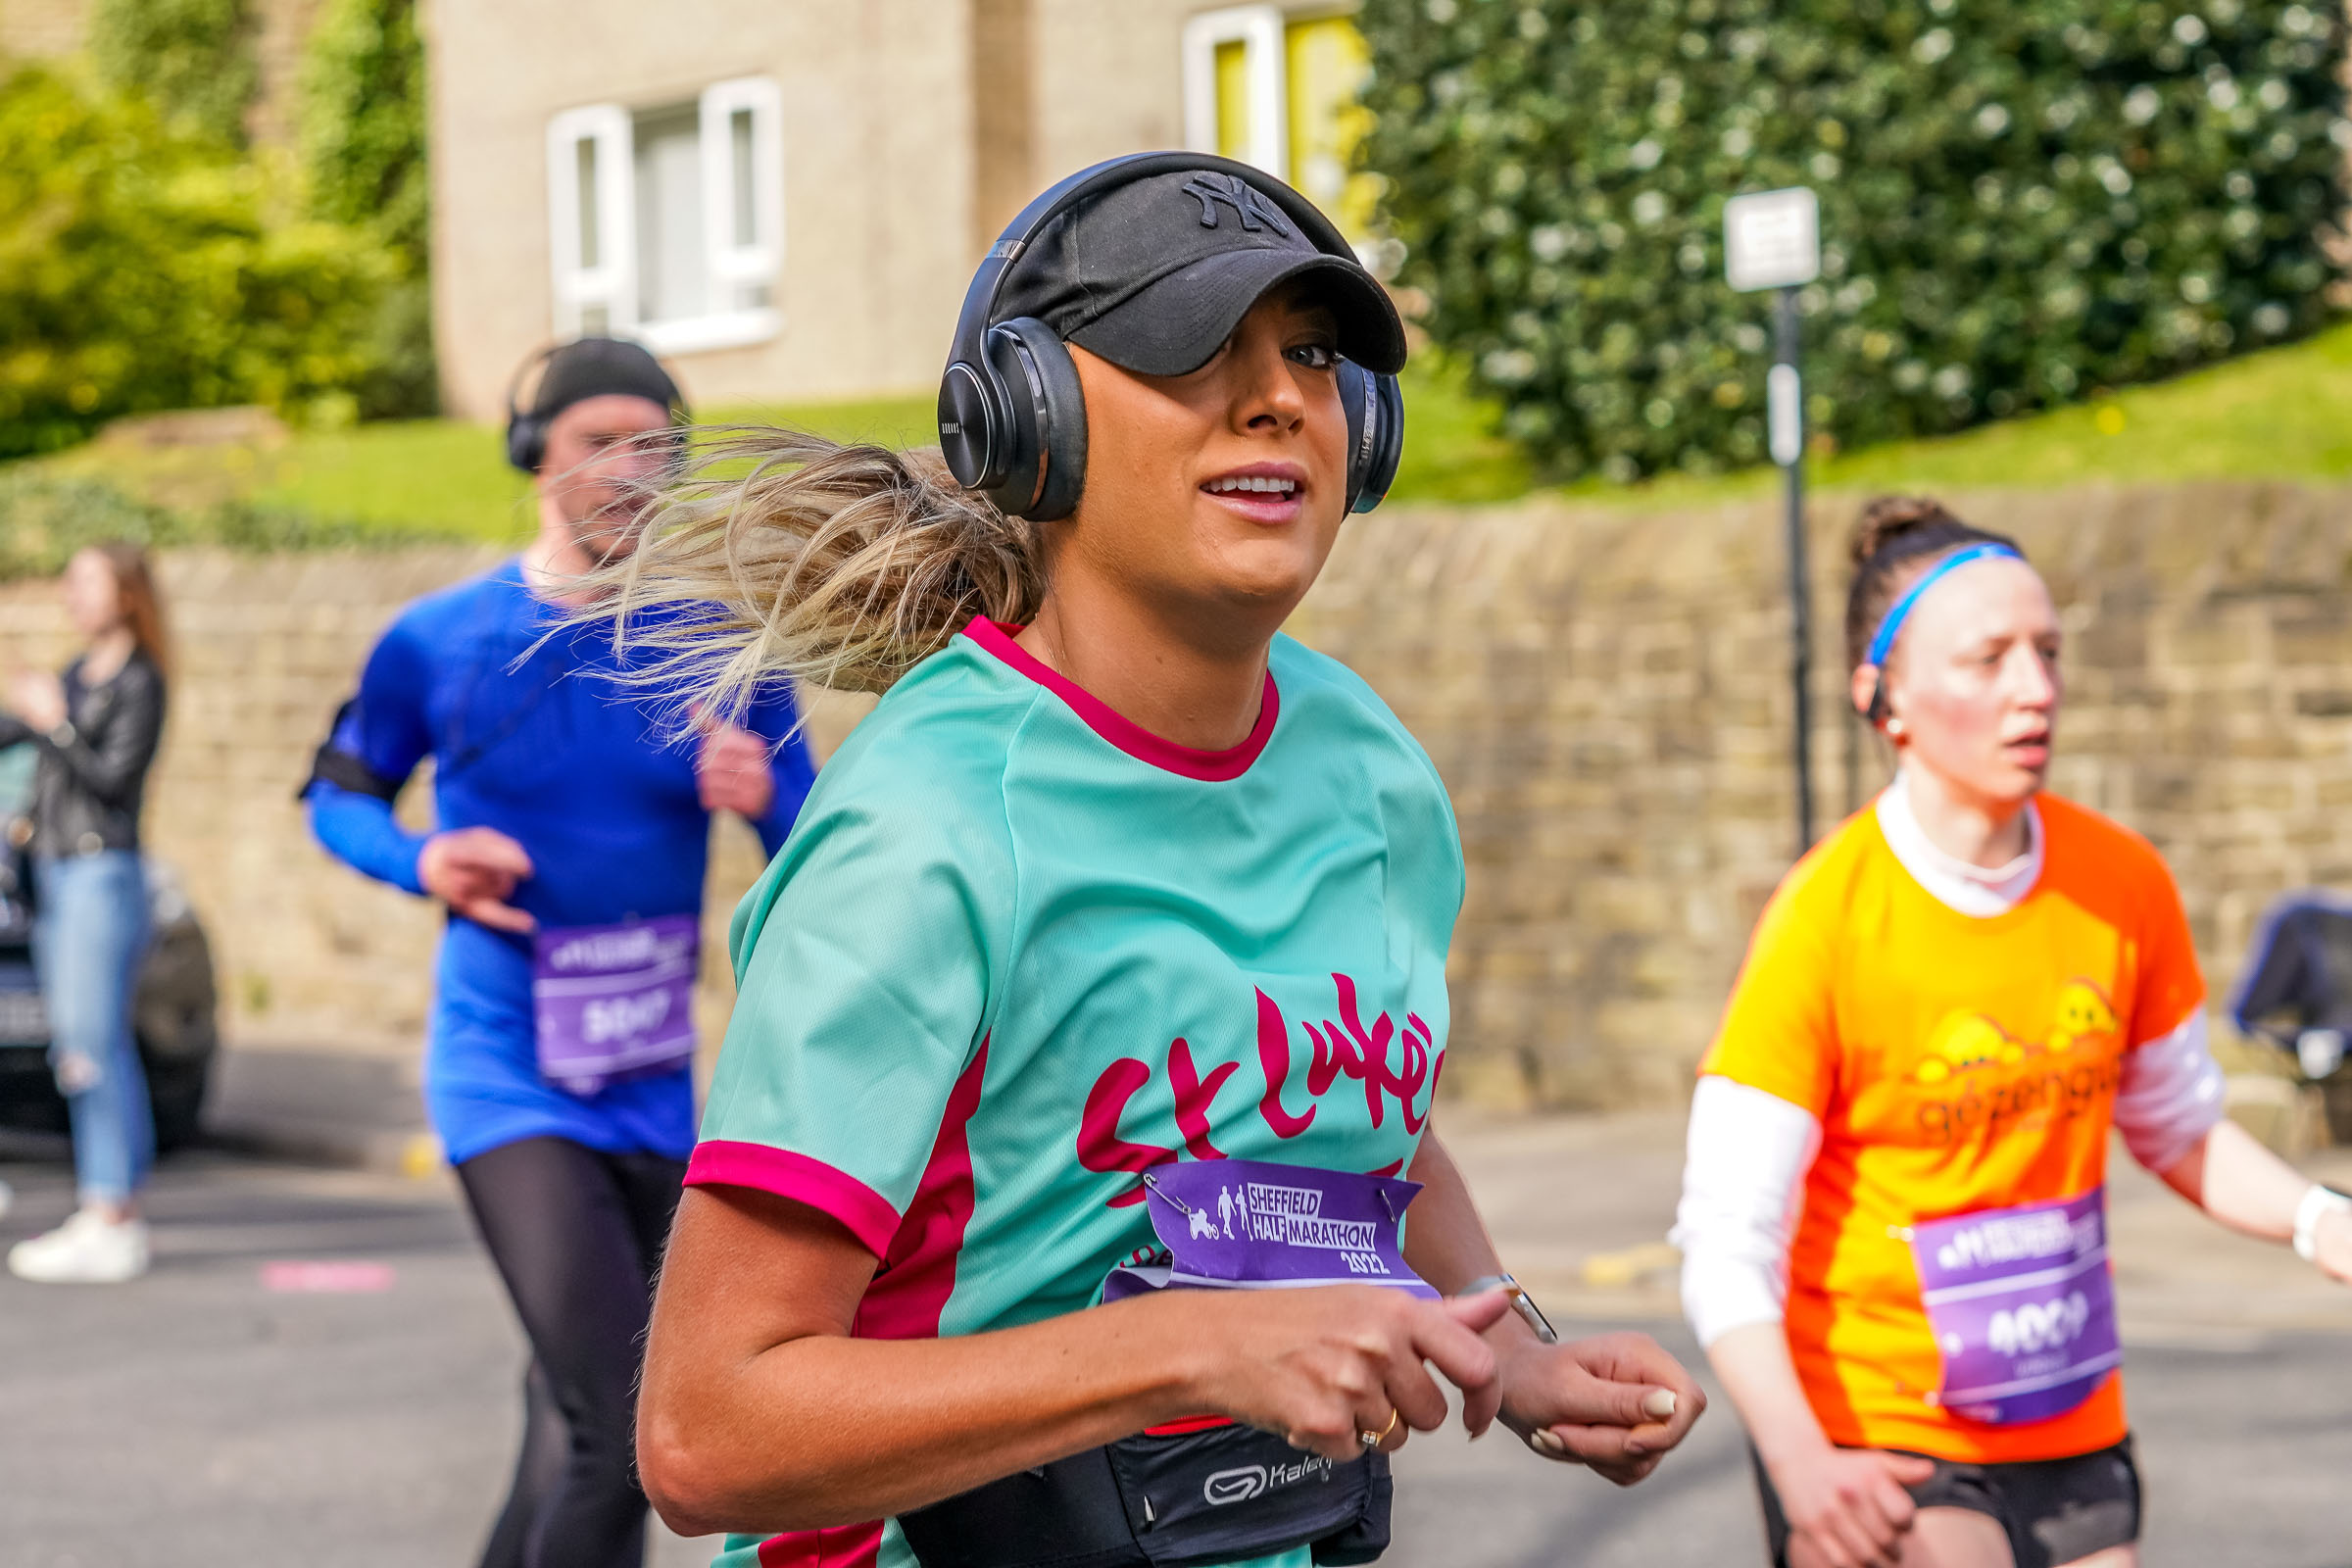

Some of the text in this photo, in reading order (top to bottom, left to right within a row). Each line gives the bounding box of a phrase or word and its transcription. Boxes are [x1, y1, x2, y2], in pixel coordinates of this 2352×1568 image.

[1250, 1186, 1319, 1214] SHEFFIELD
[1252, 1214, 1375, 1250] HALF MARATHON
[1340, 1250, 1391, 1275] 2022
